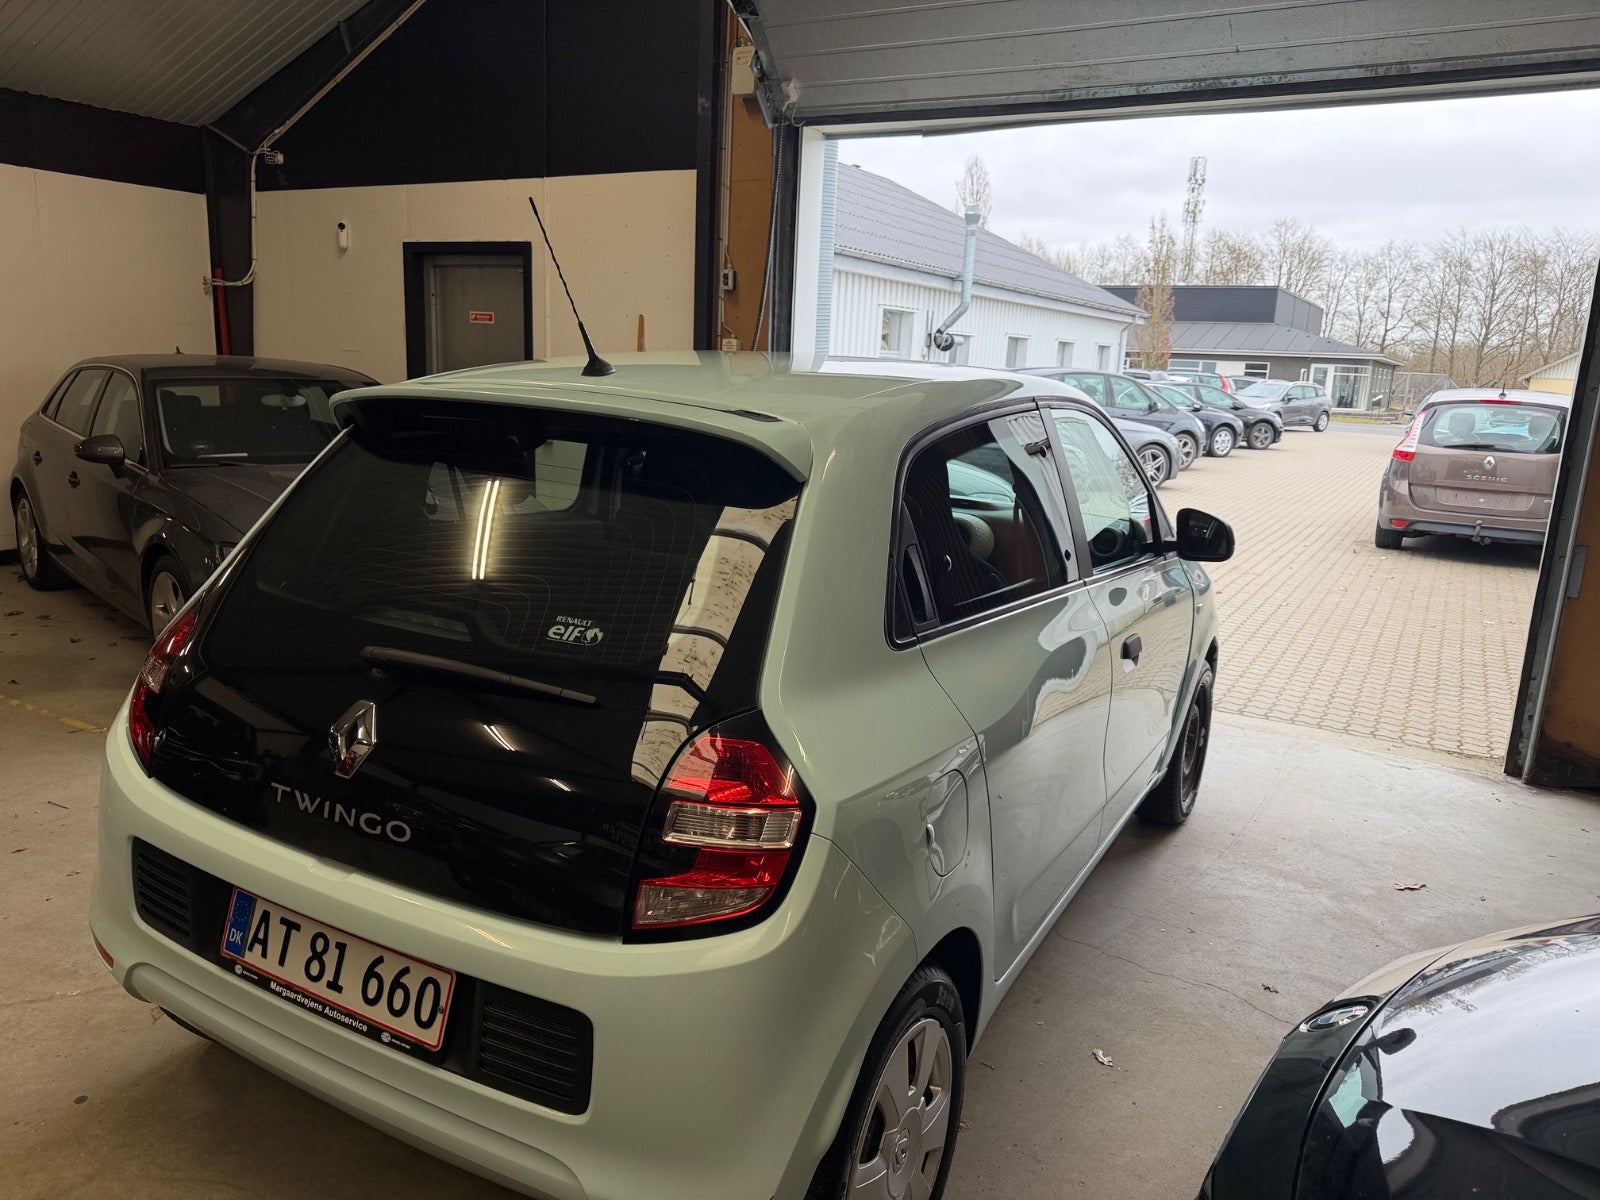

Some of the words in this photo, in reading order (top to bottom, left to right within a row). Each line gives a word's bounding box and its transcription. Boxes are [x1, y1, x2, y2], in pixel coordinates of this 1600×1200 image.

[556, 615, 593, 627] RENAULT
[270, 781, 411, 842] TWINGO
[229, 927, 244, 946] DK
[247, 909, 302, 968] AT
[304, 931, 347, 994] 81
[361, 954, 442, 1030] 660
[269, 980, 323, 1012] Margaardvejens
[323, 1006, 368, 1032] Autoservice
